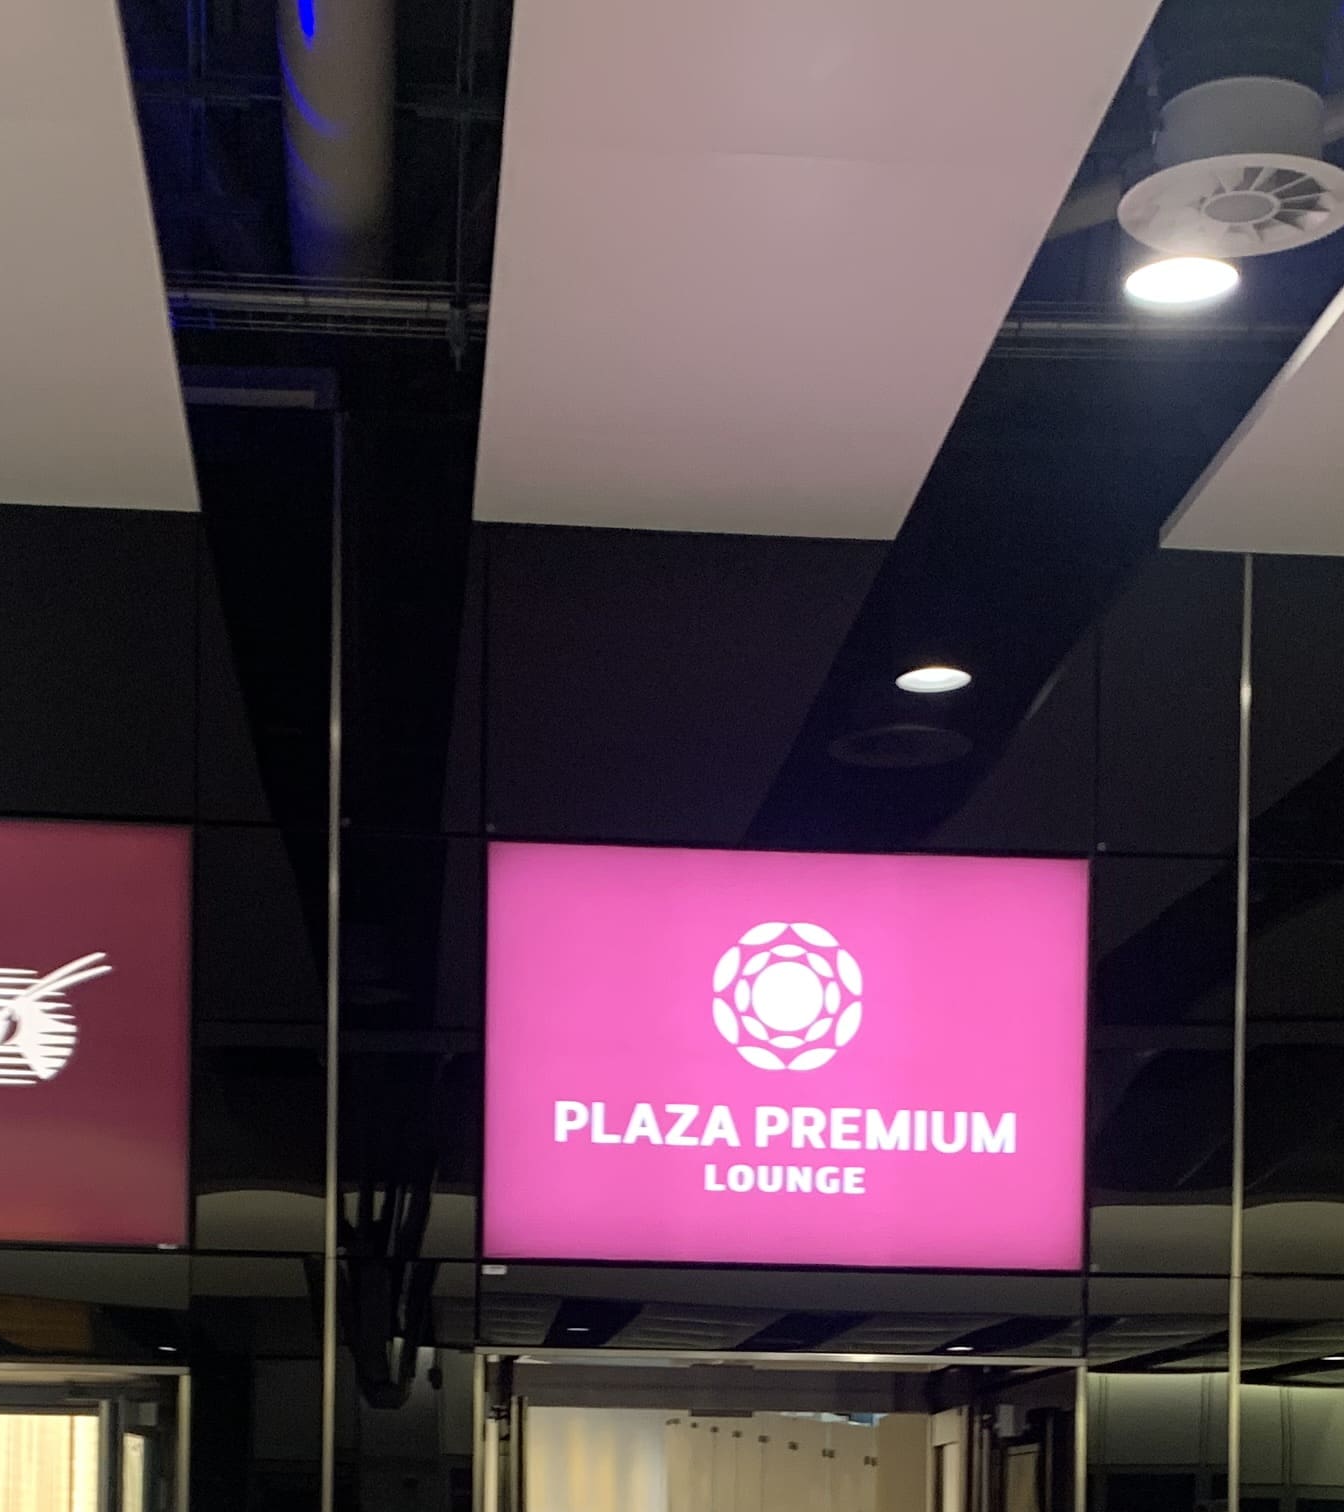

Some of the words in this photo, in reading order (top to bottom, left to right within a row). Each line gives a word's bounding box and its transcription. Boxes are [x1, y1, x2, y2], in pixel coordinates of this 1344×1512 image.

[554, 1100, 740, 1147] PLAZA
[755, 1106, 1016, 1154] PREMIUM
[704, 1164, 866, 1194] LOUNGE
